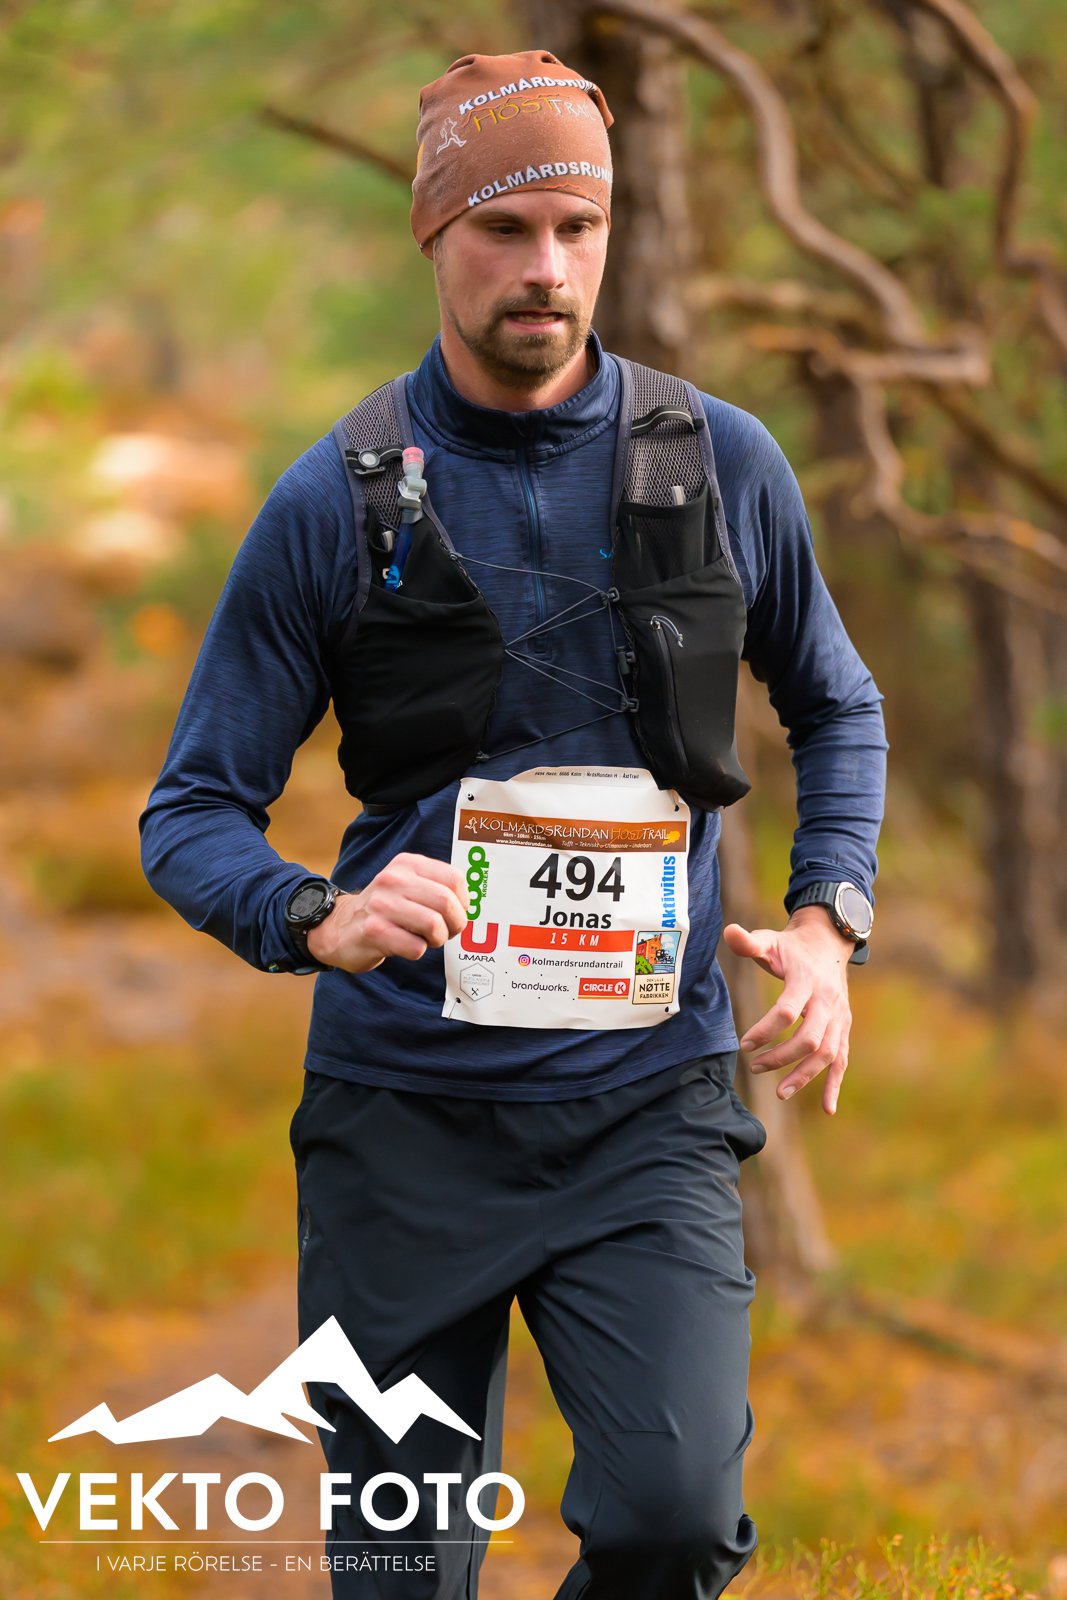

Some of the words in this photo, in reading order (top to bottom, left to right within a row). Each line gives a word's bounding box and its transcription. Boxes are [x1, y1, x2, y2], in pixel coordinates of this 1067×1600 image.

[481, 869, 489, 898] KROKEK
[529, 852, 625, 902] 494
[660, 855, 677, 929] Aktivitus
[539, 905, 612, 930] Jonas
[549, 932, 569, 945] 15
[578, 934, 600, 947] KM
[458, 953, 496, 963] UMARA
[531, 957, 624, 969] kolmardsrundantrail
[582, 983, 614, 993] CIRCLE
[638, 982, 671, 993] NØTTE
